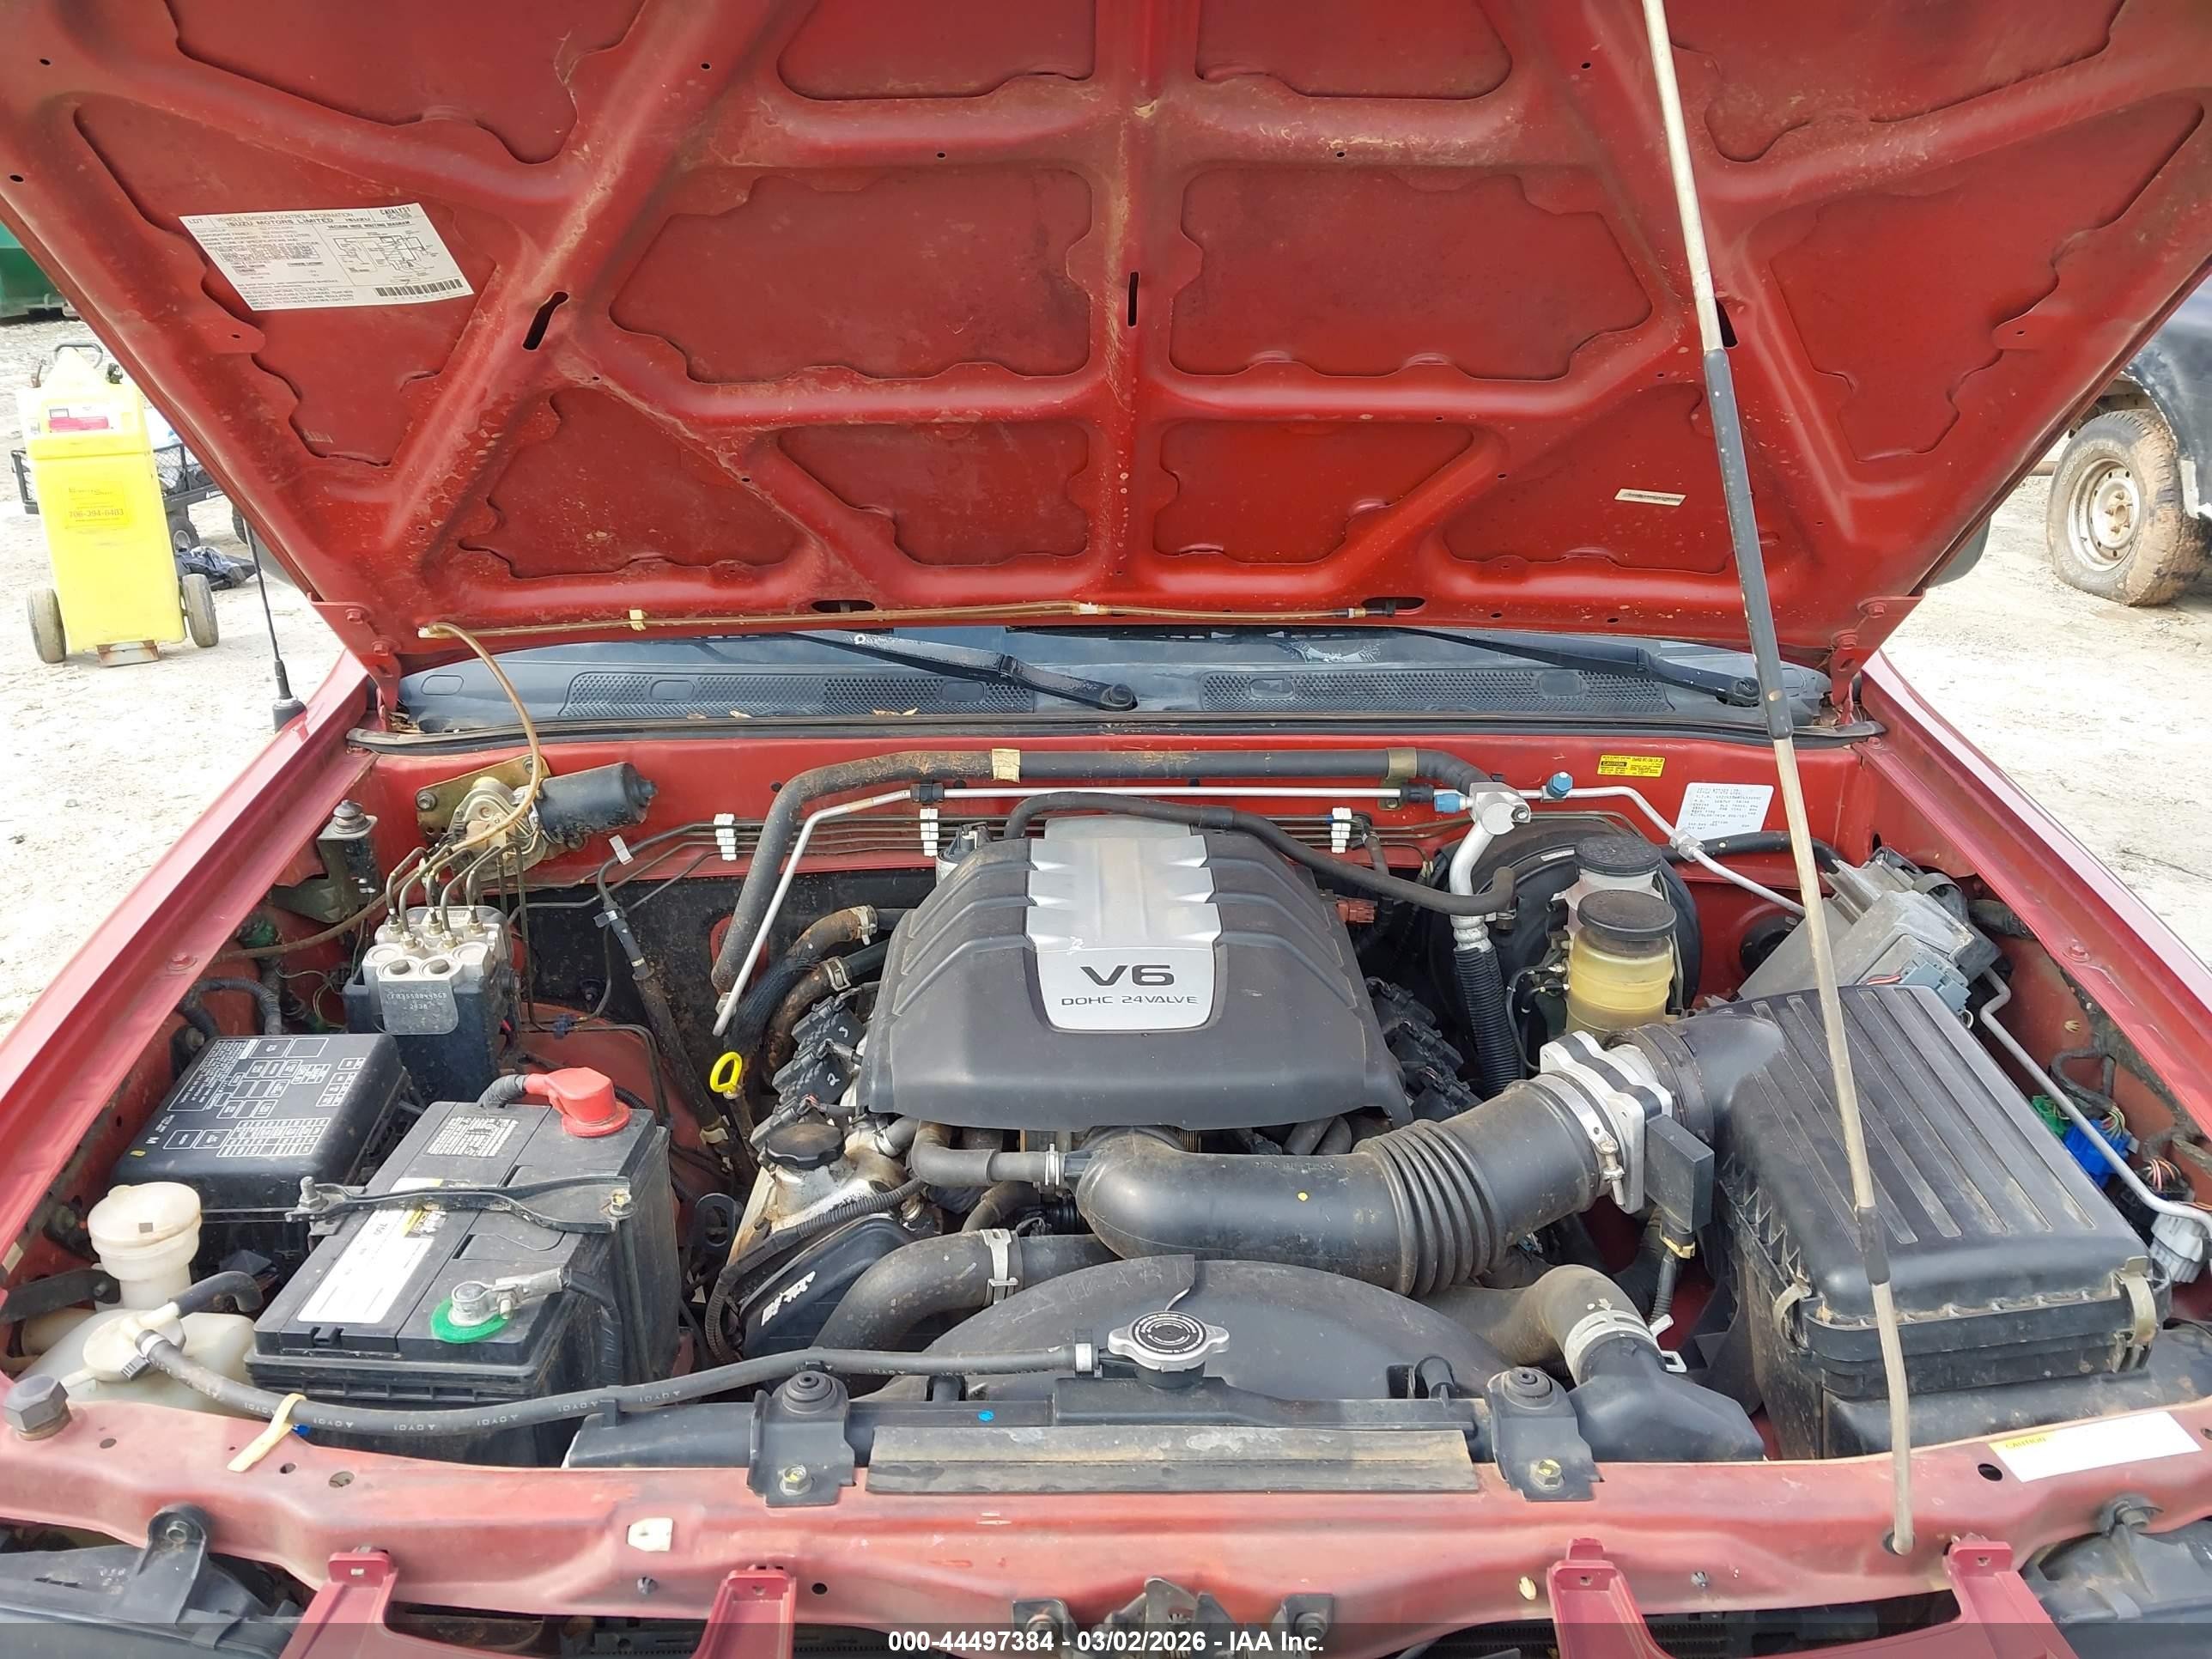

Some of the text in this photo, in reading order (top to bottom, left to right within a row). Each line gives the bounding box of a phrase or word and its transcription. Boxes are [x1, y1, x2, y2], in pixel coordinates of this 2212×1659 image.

[1080, 964, 1175, 987] V6
[1061, 995, 1200, 1006] DOHC 24VALVE
